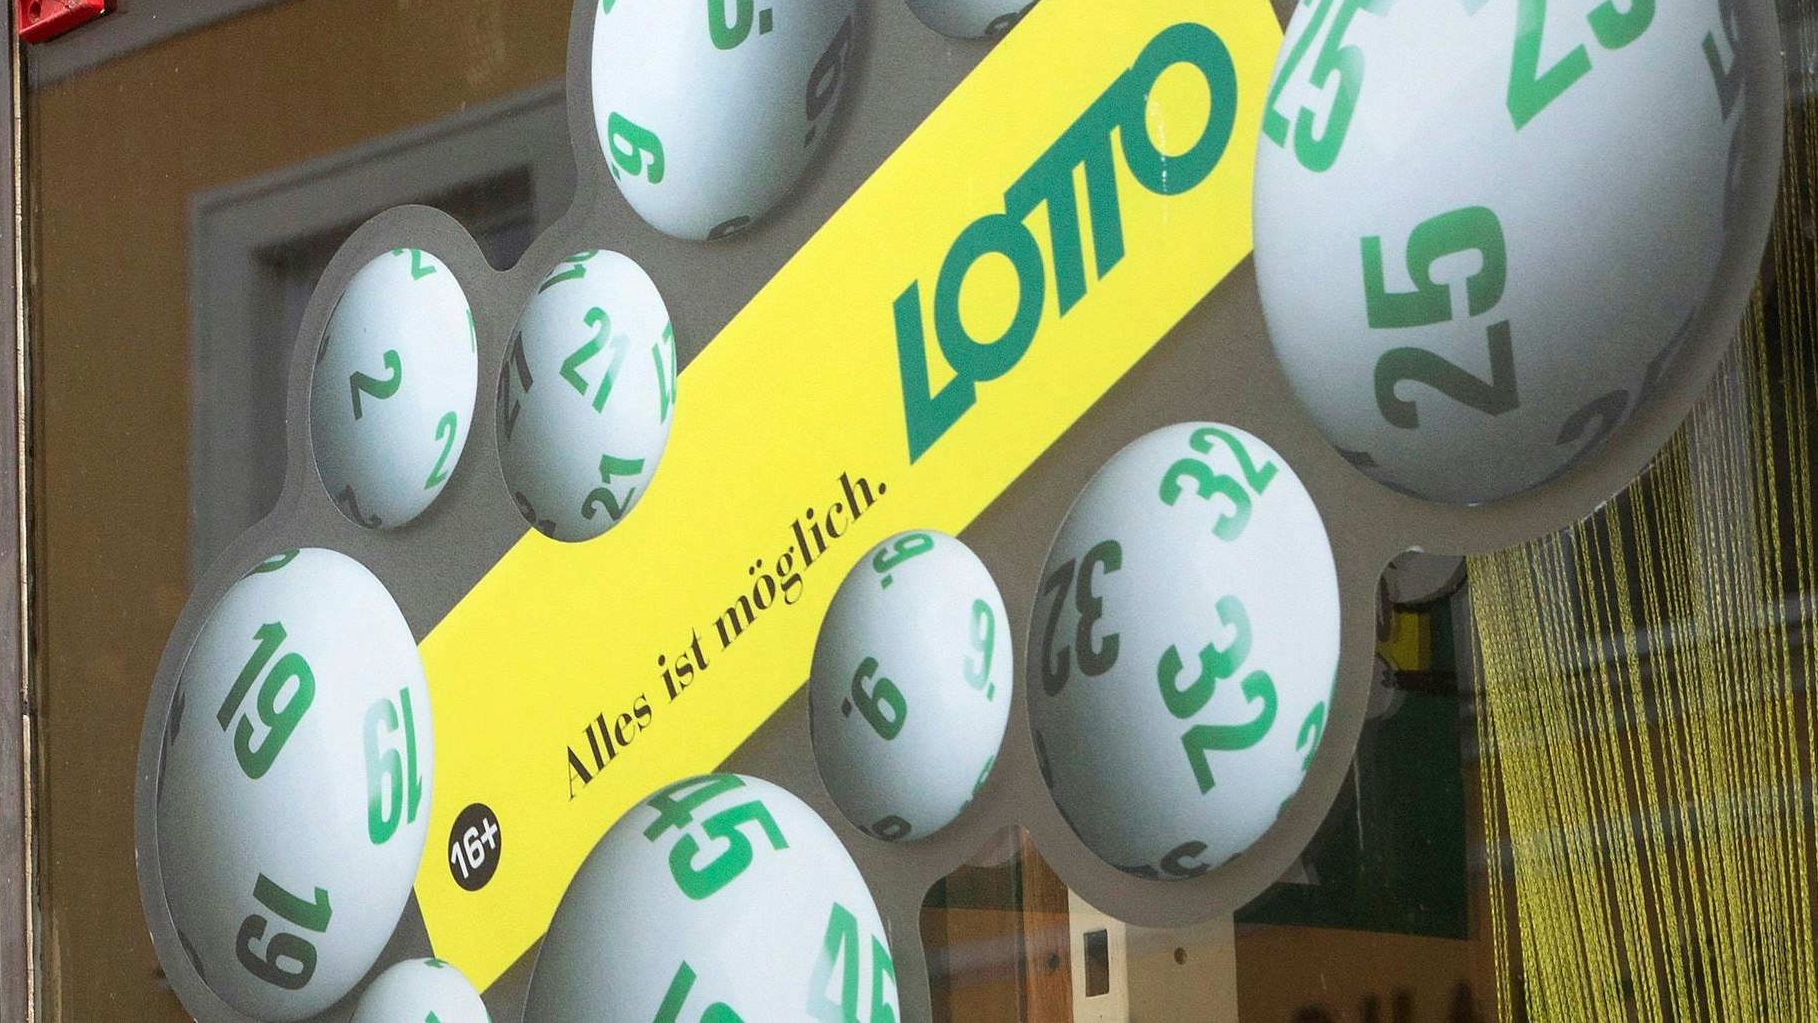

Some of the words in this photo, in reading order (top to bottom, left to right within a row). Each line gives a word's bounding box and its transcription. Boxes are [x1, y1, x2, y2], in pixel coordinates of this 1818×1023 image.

[893, 22, 1238, 466] LOTTO
[559, 306, 629, 414] 21
[1360, 205, 1520, 429] 25
[349, 349, 403, 421] 2
[423, 411, 458, 491] 2
[581, 454, 646, 521] 21
[1158, 427, 1279, 542] 32
[567, 712, 653, 802] Alles
[658, 626, 710, 705] ist
[712, 471, 886, 653] möglich.
[1041, 539, 1123, 697] 32
[216, 620, 316, 780] 19
[1157, 595, 1278, 795] 32
[362, 687, 423, 846] 19
[450, 818, 498, 879] 16+
[643, 772, 790, 901] 45
[235, 873, 333, 990] 19
